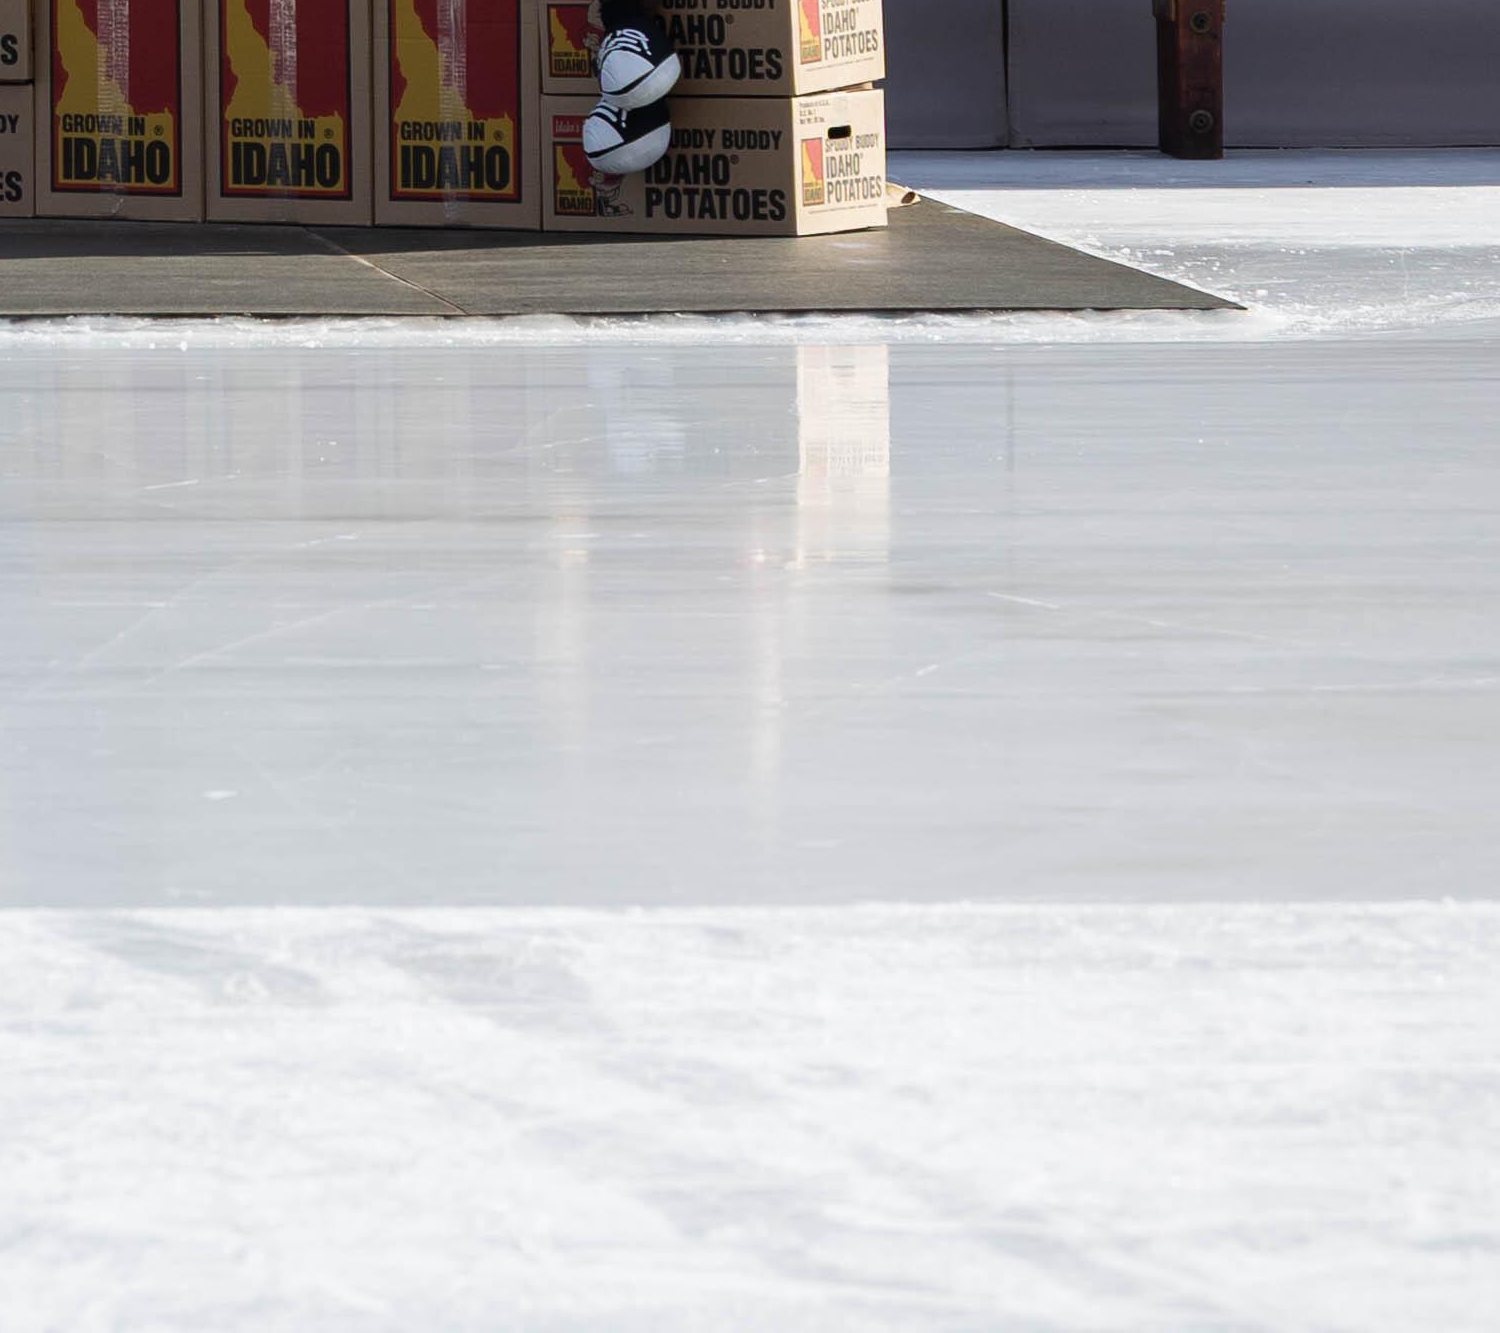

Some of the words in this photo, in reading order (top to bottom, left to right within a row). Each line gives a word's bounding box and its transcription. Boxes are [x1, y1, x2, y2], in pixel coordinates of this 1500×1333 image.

[824, 29, 878, 60] POTATOES
[678, 48, 782, 80] TATOES
[61, 113, 123, 134] GROWN
[127, 117, 145, 136] IN
[231, 118, 292, 139] GROWN
[297, 120, 315, 140] IN
[400, 121, 462, 140] GROWN
[467, 121, 485, 141] IN
[669, 129, 716, 149] UDDY
[722, 129, 782, 150] BUDDY
[61, 137, 171, 185] IDAHO
[231, 142, 341, 189] IDAHO
[400, 145, 510, 191] IDAHO
[645, 187, 786, 221] POTATOES
[827, 175, 882, 203] POTATOES
